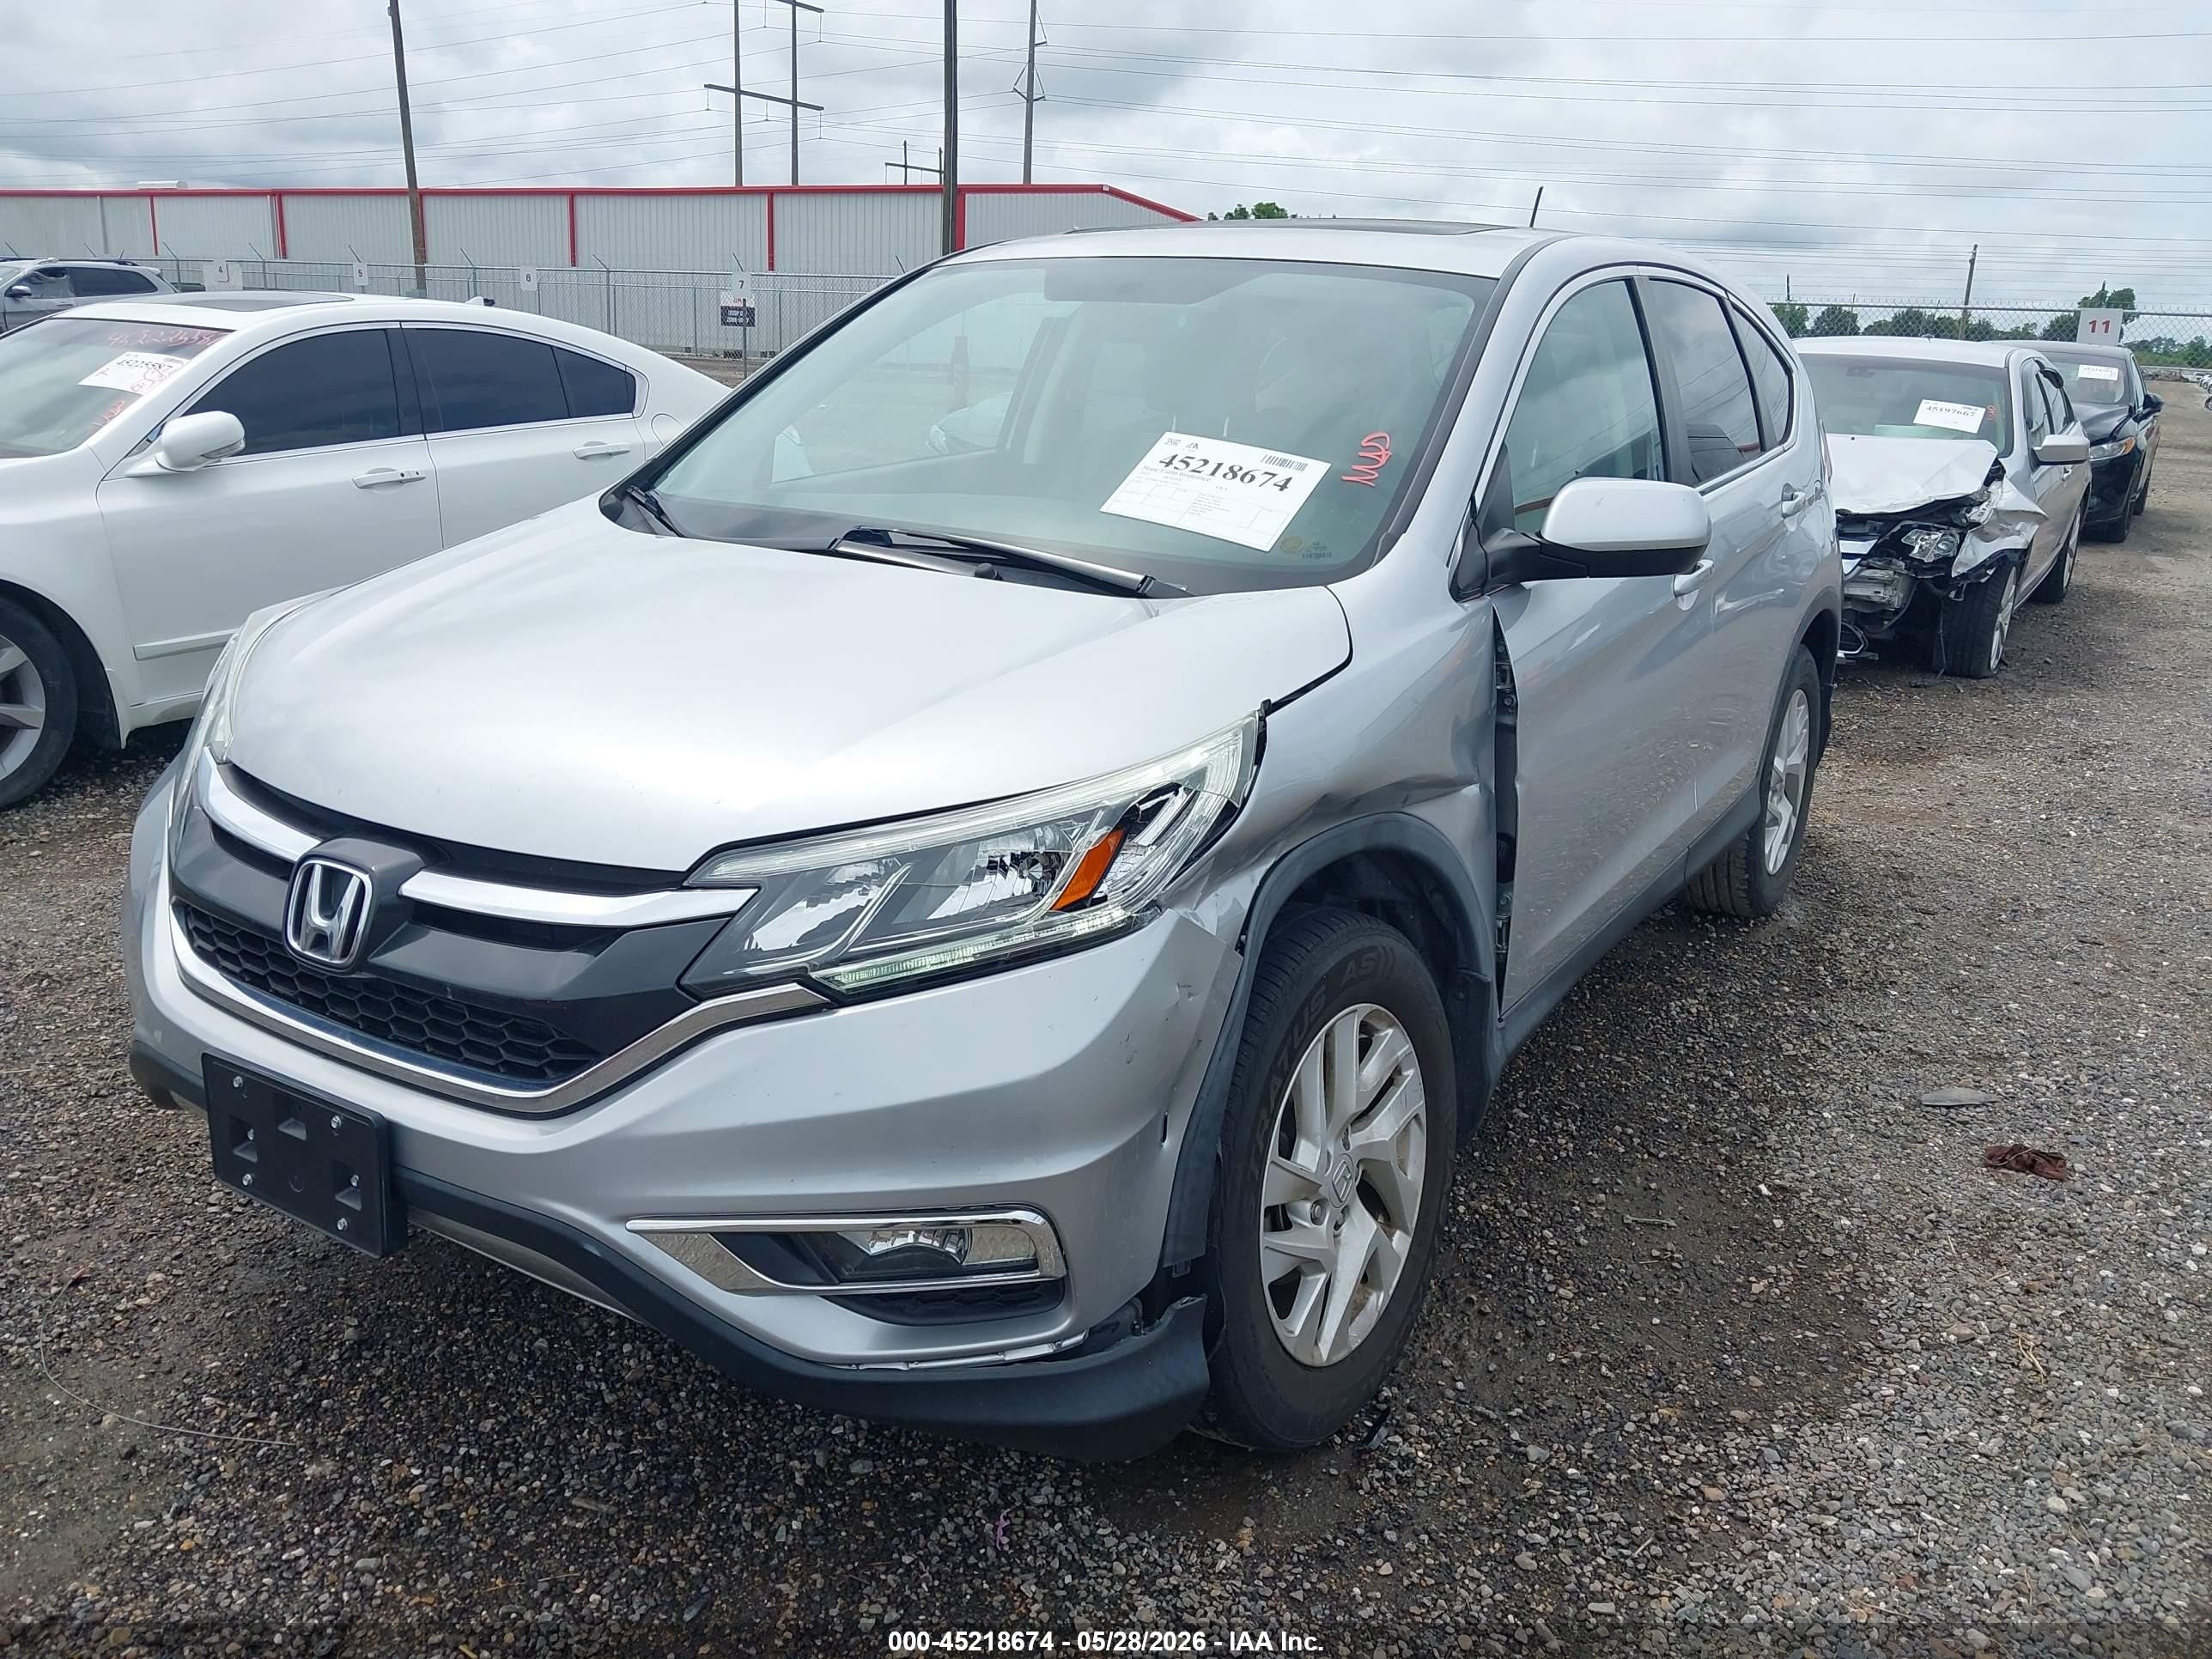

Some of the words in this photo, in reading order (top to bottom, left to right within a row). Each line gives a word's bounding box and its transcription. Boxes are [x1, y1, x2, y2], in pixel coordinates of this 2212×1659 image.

[357, 269, 363, 277] 5
[526, 273, 532, 283] 6
[738, 280, 744, 289] 7
[2088, 319, 2111, 334] 11
[1925, 405, 1977, 417] 45197667
[1159, 453, 1293, 492] 45218674
